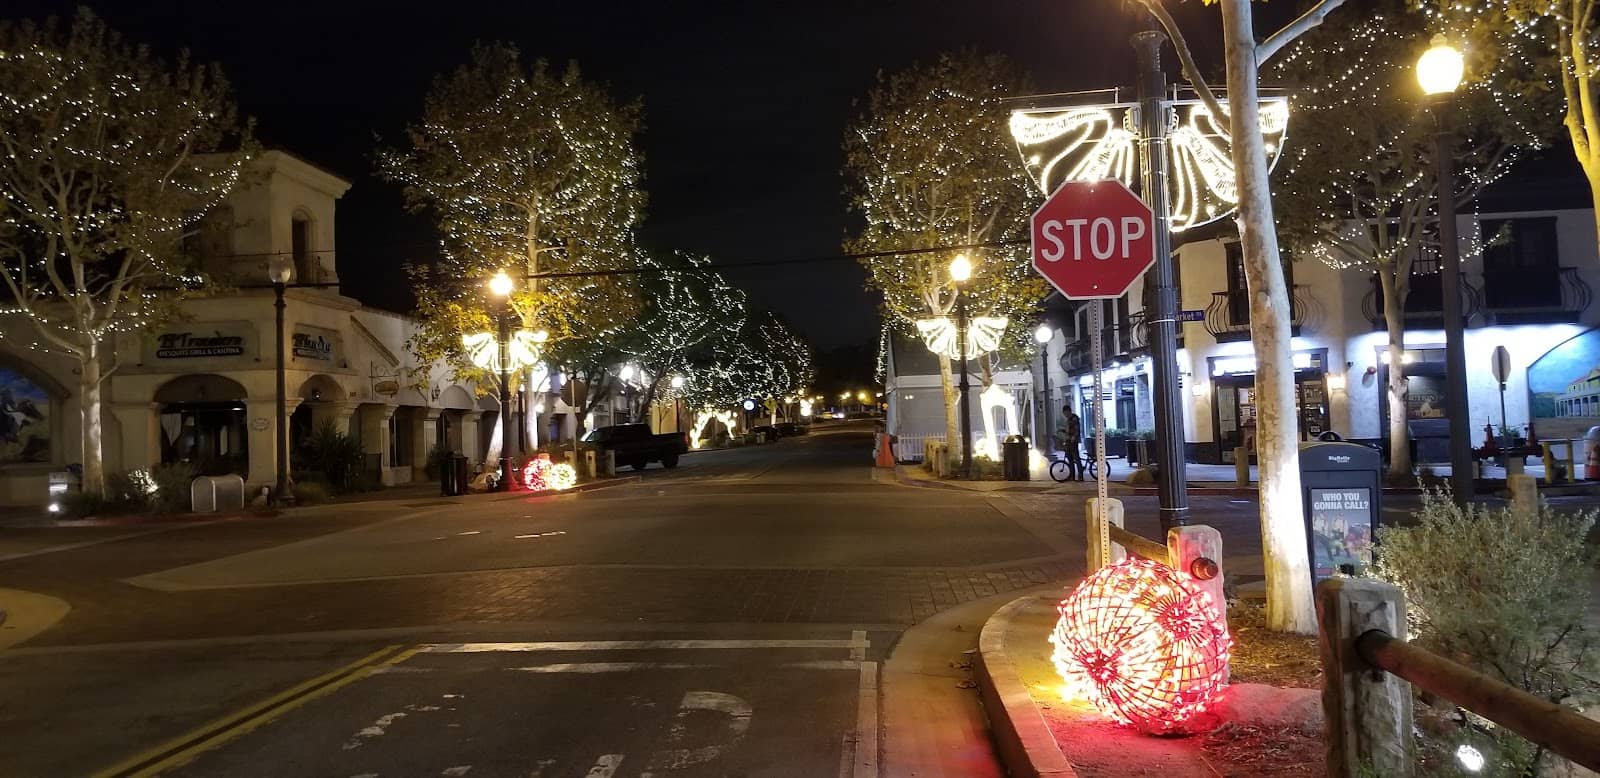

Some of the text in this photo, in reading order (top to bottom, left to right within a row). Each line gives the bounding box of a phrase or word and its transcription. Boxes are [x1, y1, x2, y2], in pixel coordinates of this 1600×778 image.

[1041, 216, 1145, 262] STOP
[1175, 311, 1194, 322] arket
[1322, 492, 1360, 502] WHO YOU
[1313, 501, 1369, 510] GONNA CALL?
